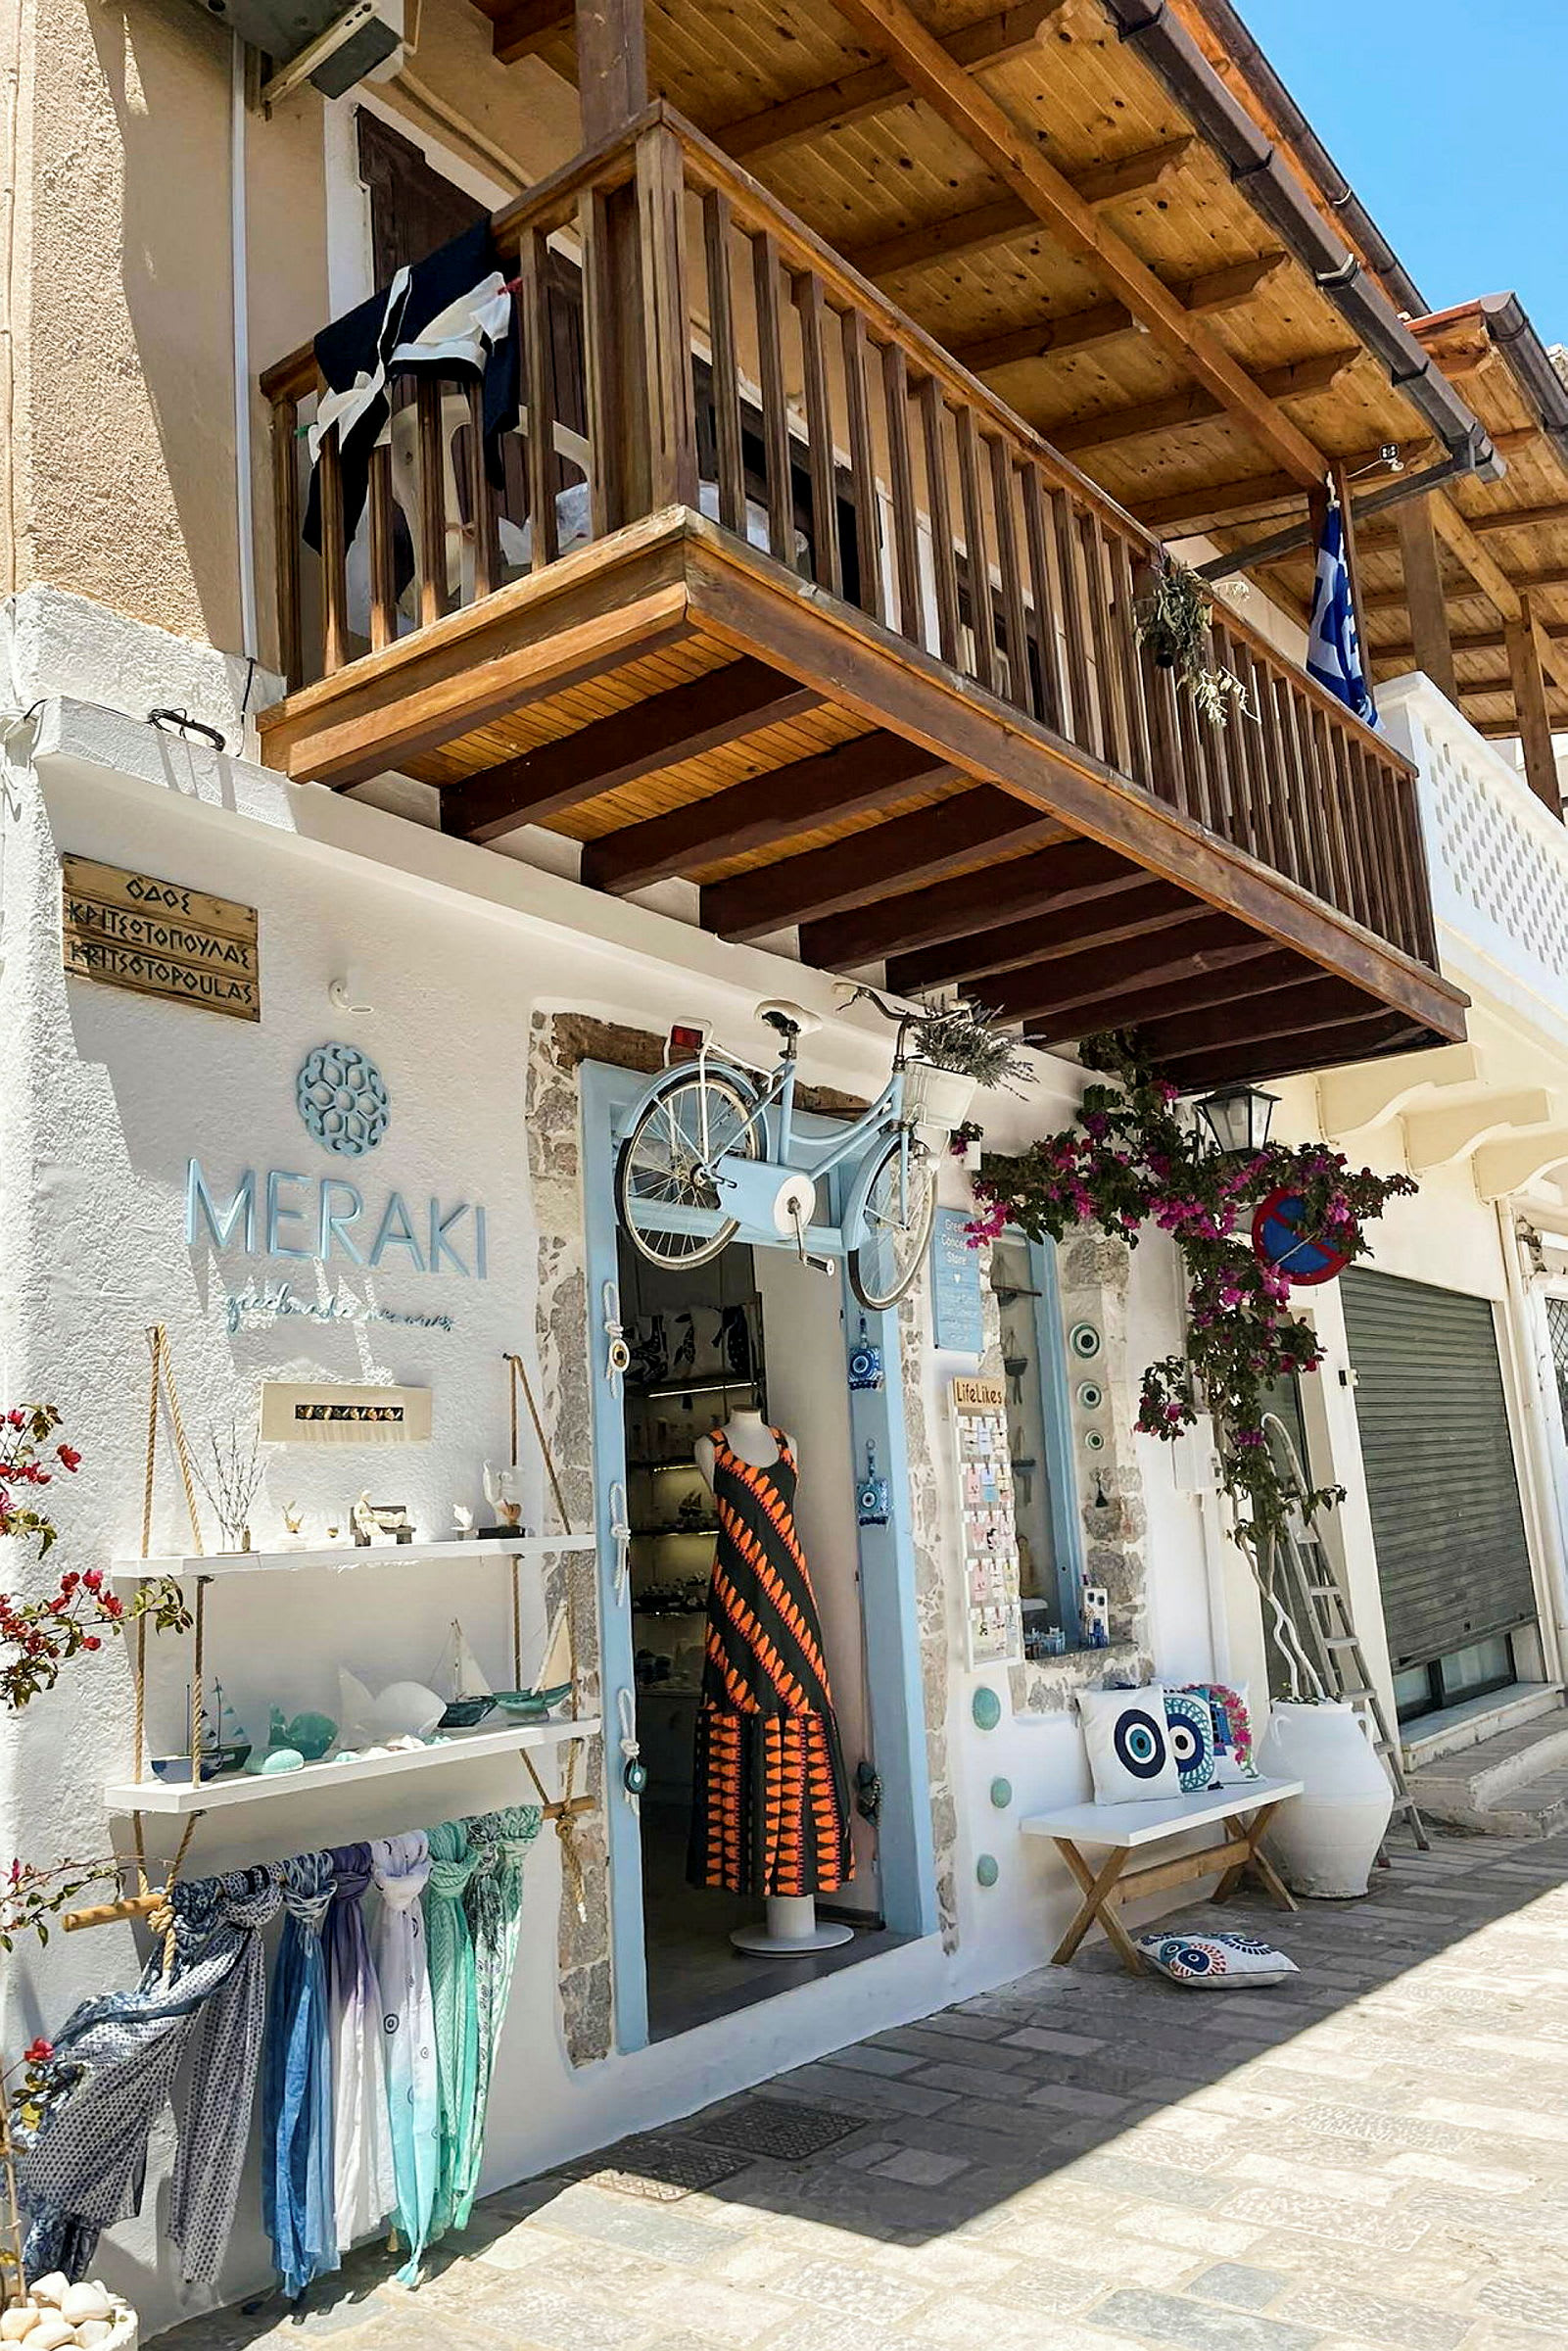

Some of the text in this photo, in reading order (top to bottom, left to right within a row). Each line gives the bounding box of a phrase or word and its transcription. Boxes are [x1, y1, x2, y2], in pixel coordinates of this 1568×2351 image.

[71, 941, 252, 1004] KRITSOTOPOULAS
[186, 1156, 487, 1279] MERAKI
[945, 1219, 965, 1233] Gree
[956, 1381, 1002, 1405] LifeLikes
